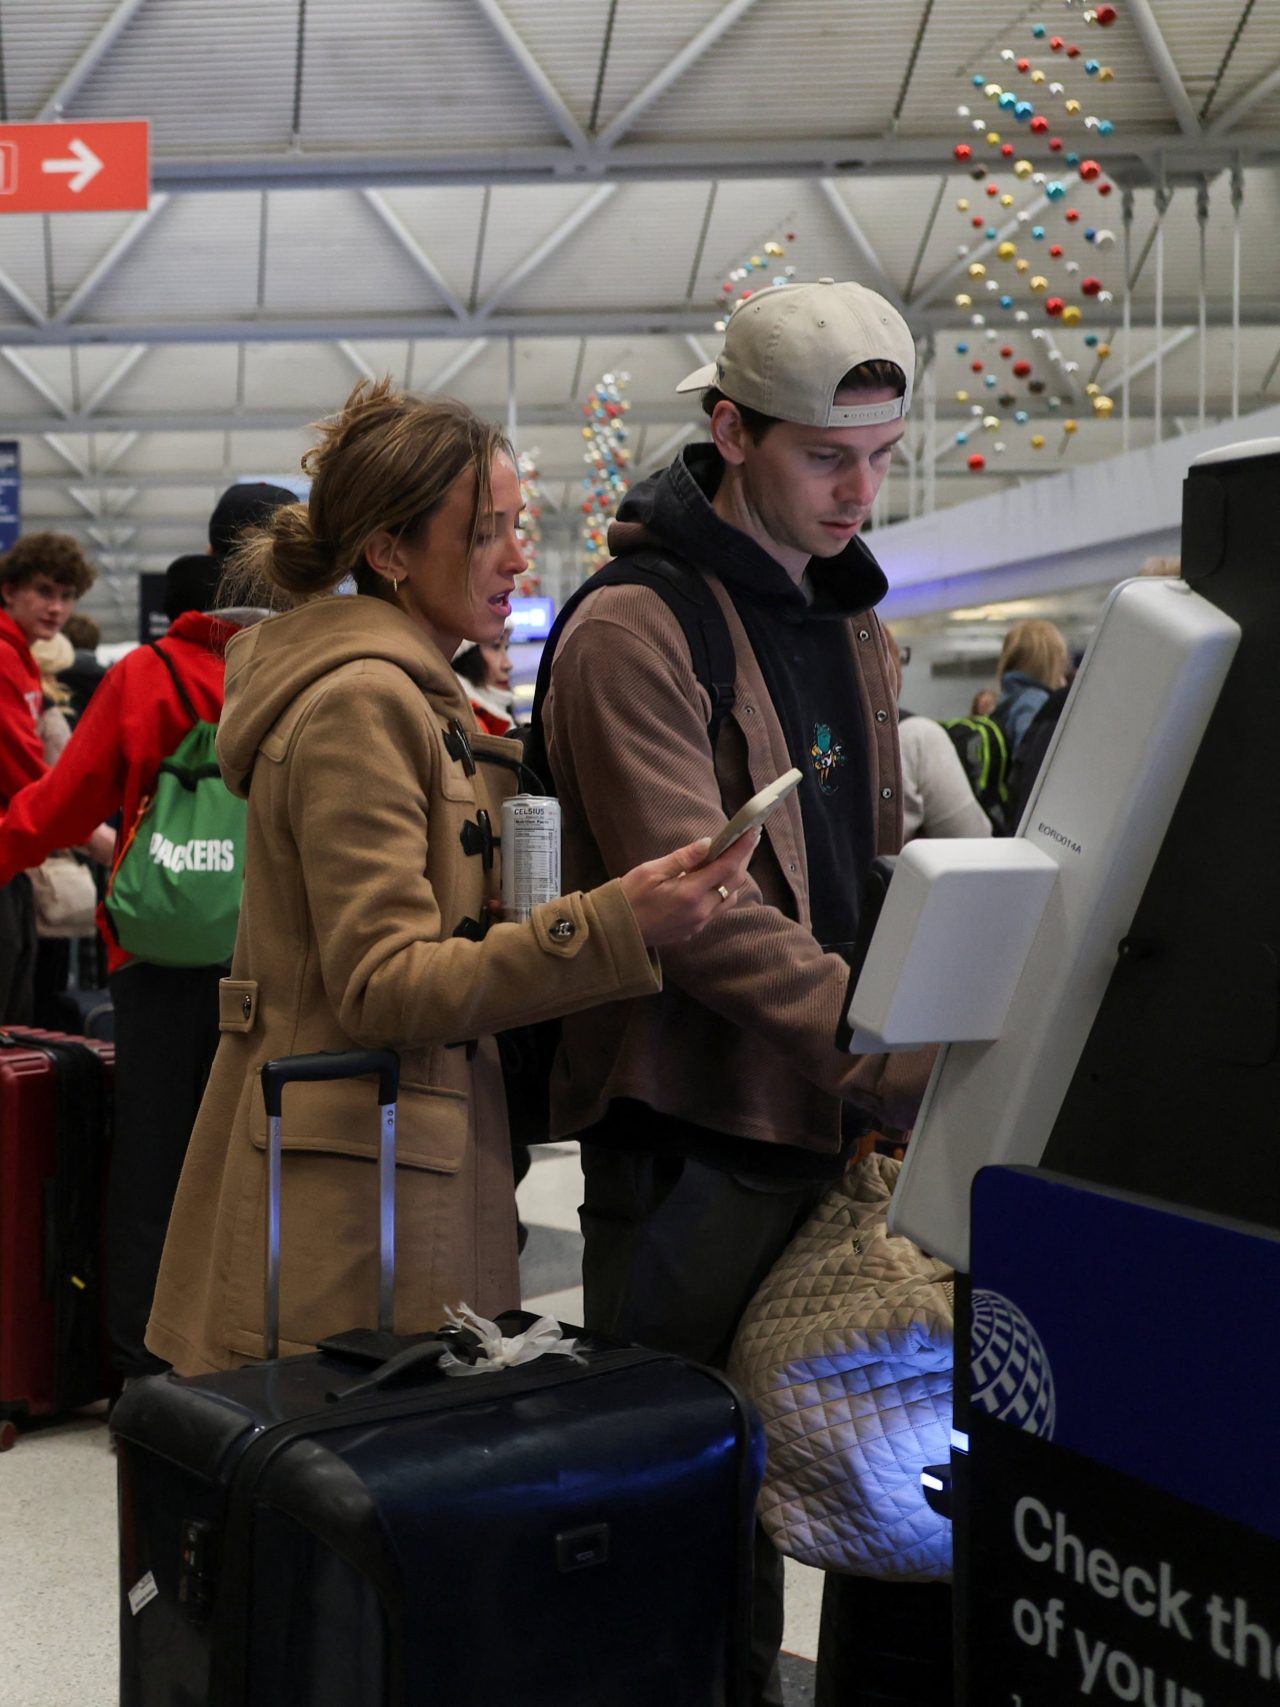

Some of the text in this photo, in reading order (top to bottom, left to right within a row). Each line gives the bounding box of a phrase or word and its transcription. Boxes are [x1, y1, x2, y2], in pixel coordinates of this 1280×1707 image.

[514, 808, 545, 816] CELSIUS
[1013, 1495, 1280, 1681] Check th
[1012, 1597, 1065, 1659] of
